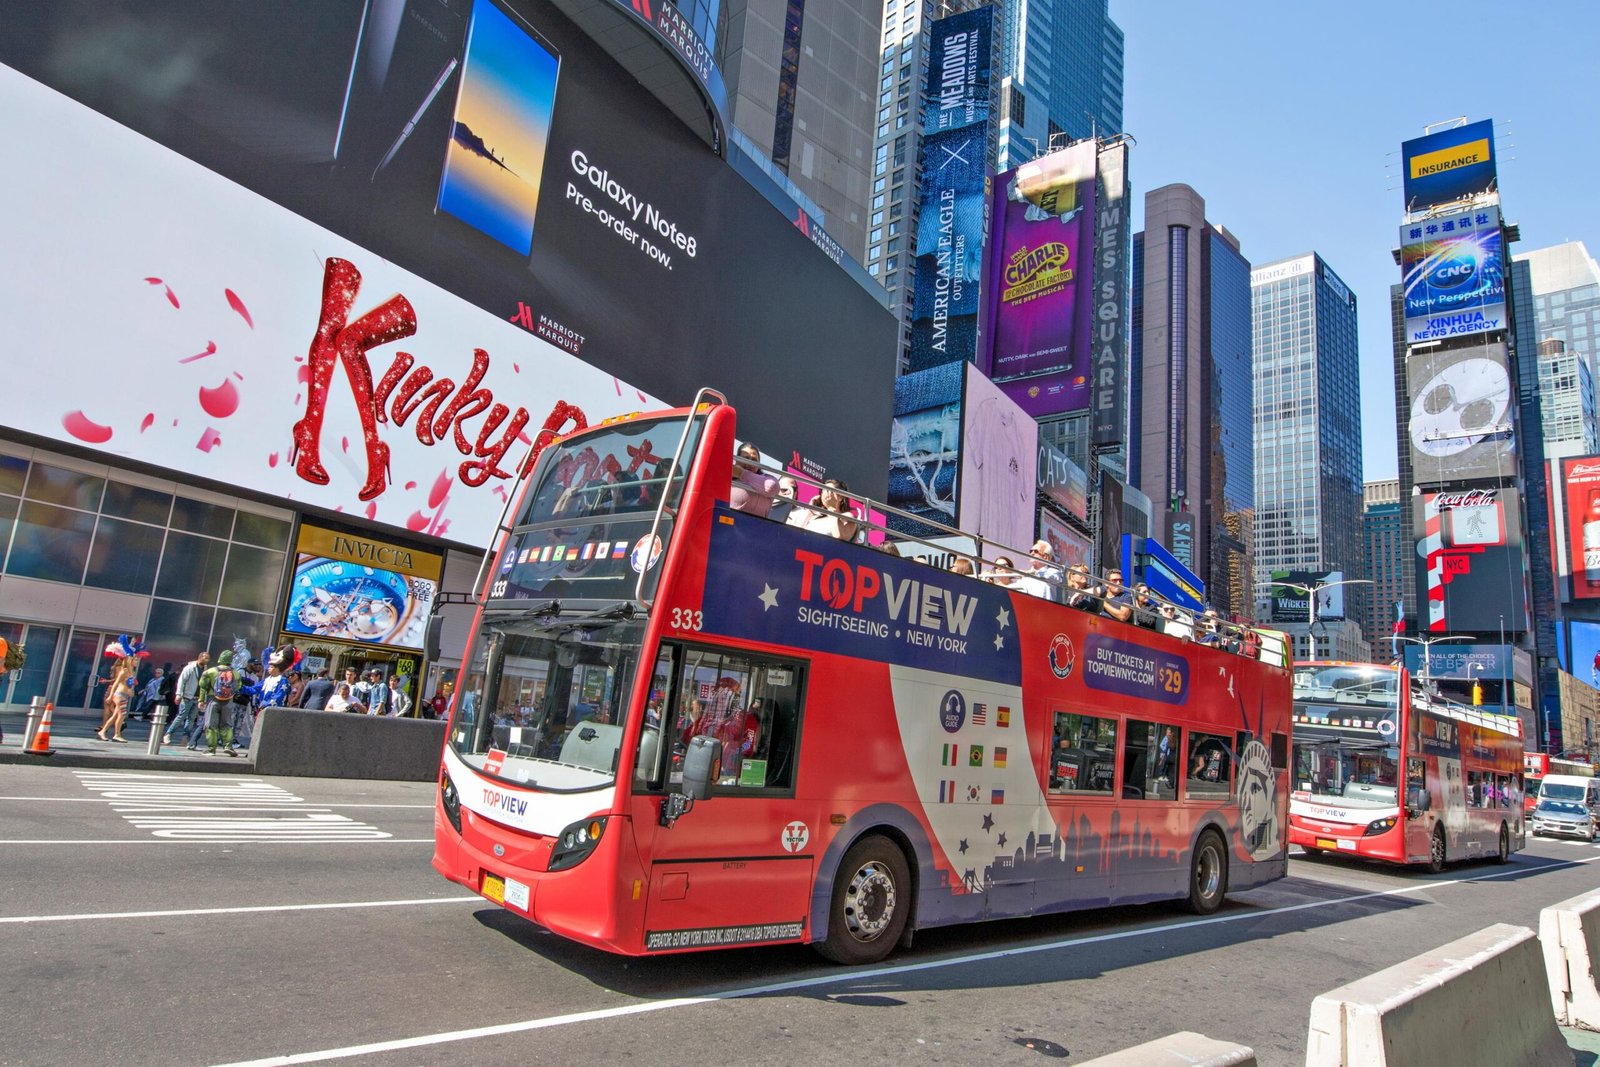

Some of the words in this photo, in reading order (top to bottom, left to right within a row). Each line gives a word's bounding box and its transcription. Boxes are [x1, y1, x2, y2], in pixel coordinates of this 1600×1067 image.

[662, 1, 714, 70] MARRIOTT
[968, 28, 979, 64] FESTIVAL
[659, 17, 709, 81] MARQUIS
[940, 32, 968, 110] MEADOWS
[967, 65, 977, 84] ARTS
[939, 113, 949, 128] THE
[965, 98, 975, 123] MUSIC
[1418, 154, 1479, 177] INSURANCE
[571, 150, 644, 221] Galaxy
[646, 204, 697, 258] Note8
[566, 182, 639, 246] Pre-order
[641, 238, 673, 270] now.
[939, 188, 955, 247] EAGLE
[1409, 214, 1489, 240] 新华通讯社
[812, 235, 840, 264] MARQUIS
[813, 224, 844, 257] MARRIOTT
[952, 234, 965, 301] OUTFITTERS
[1006, 244, 1065, 283] CHARLIE
[1250, 267, 1286, 283] Allianz
[1436, 262, 1472, 279] CNC
[1012, 279, 1045, 298] CHOCOLATE
[1047, 271, 1070, 286] FACTORY
[1039, 284, 1065, 297] MUSICAL
[932, 250, 951, 352] AMERICAN
[1410, 297, 1436, 309] New
[540, 315, 585, 344] MARRIOTT
[1414, 326, 1447, 341] NEWS
[1449, 319, 1499, 335] AGENCY
[1427, 311, 1484, 330] XINHUA
[538, 325, 579, 352] MARQUIS
[1098, 280, 1119, 410] SQUARE
[293, 257, 530, 501] Kinky
[1098, 424, 1113, 432] NYC
[802, 464, 823, 480] MARQUIS
[803, 457, 826, 474] MARRIOTT
[1037, 446, 1068, 488] CATS
[1432, 489, 1497, 510] Coca-Cola
[331, 536, 414, 569] INVICTA
[1446, 559, 1464, 570] NYC
[407, 591, 430, 602] FREE
[409, 580, 431, 590] BOGO
[491, 581, 508, 597] 333
[795, 549, 978, 636] TOPVIEW
[670, 607, 704, 631] 333
[798, 607, 888, 638] SIGHTSEEING
[907, 629, 933, 648] NEW
[937, 635, 967, 654] YORK
[1087, 660, 1154, 686] TOPVIEWNYC.COM
[1096, 648, 1112, 662] BUY
[1114, 652, 1143, 668] TICKETS
[1144, 660, 1154, 672] AT
[1418, 660, 1442, 669] ARE
[1159, 667, 1182, 694] $29
[483, 788, 528, 816] TOPVIEW
[1310, 806, 1347, 818] TOPVIEW
[723, 862, 746, 870] BATTERY
[672, 933, 680, 947] GO
[680, 932, 690, 946] NEW
[689, 931, 702, 945] YORK
